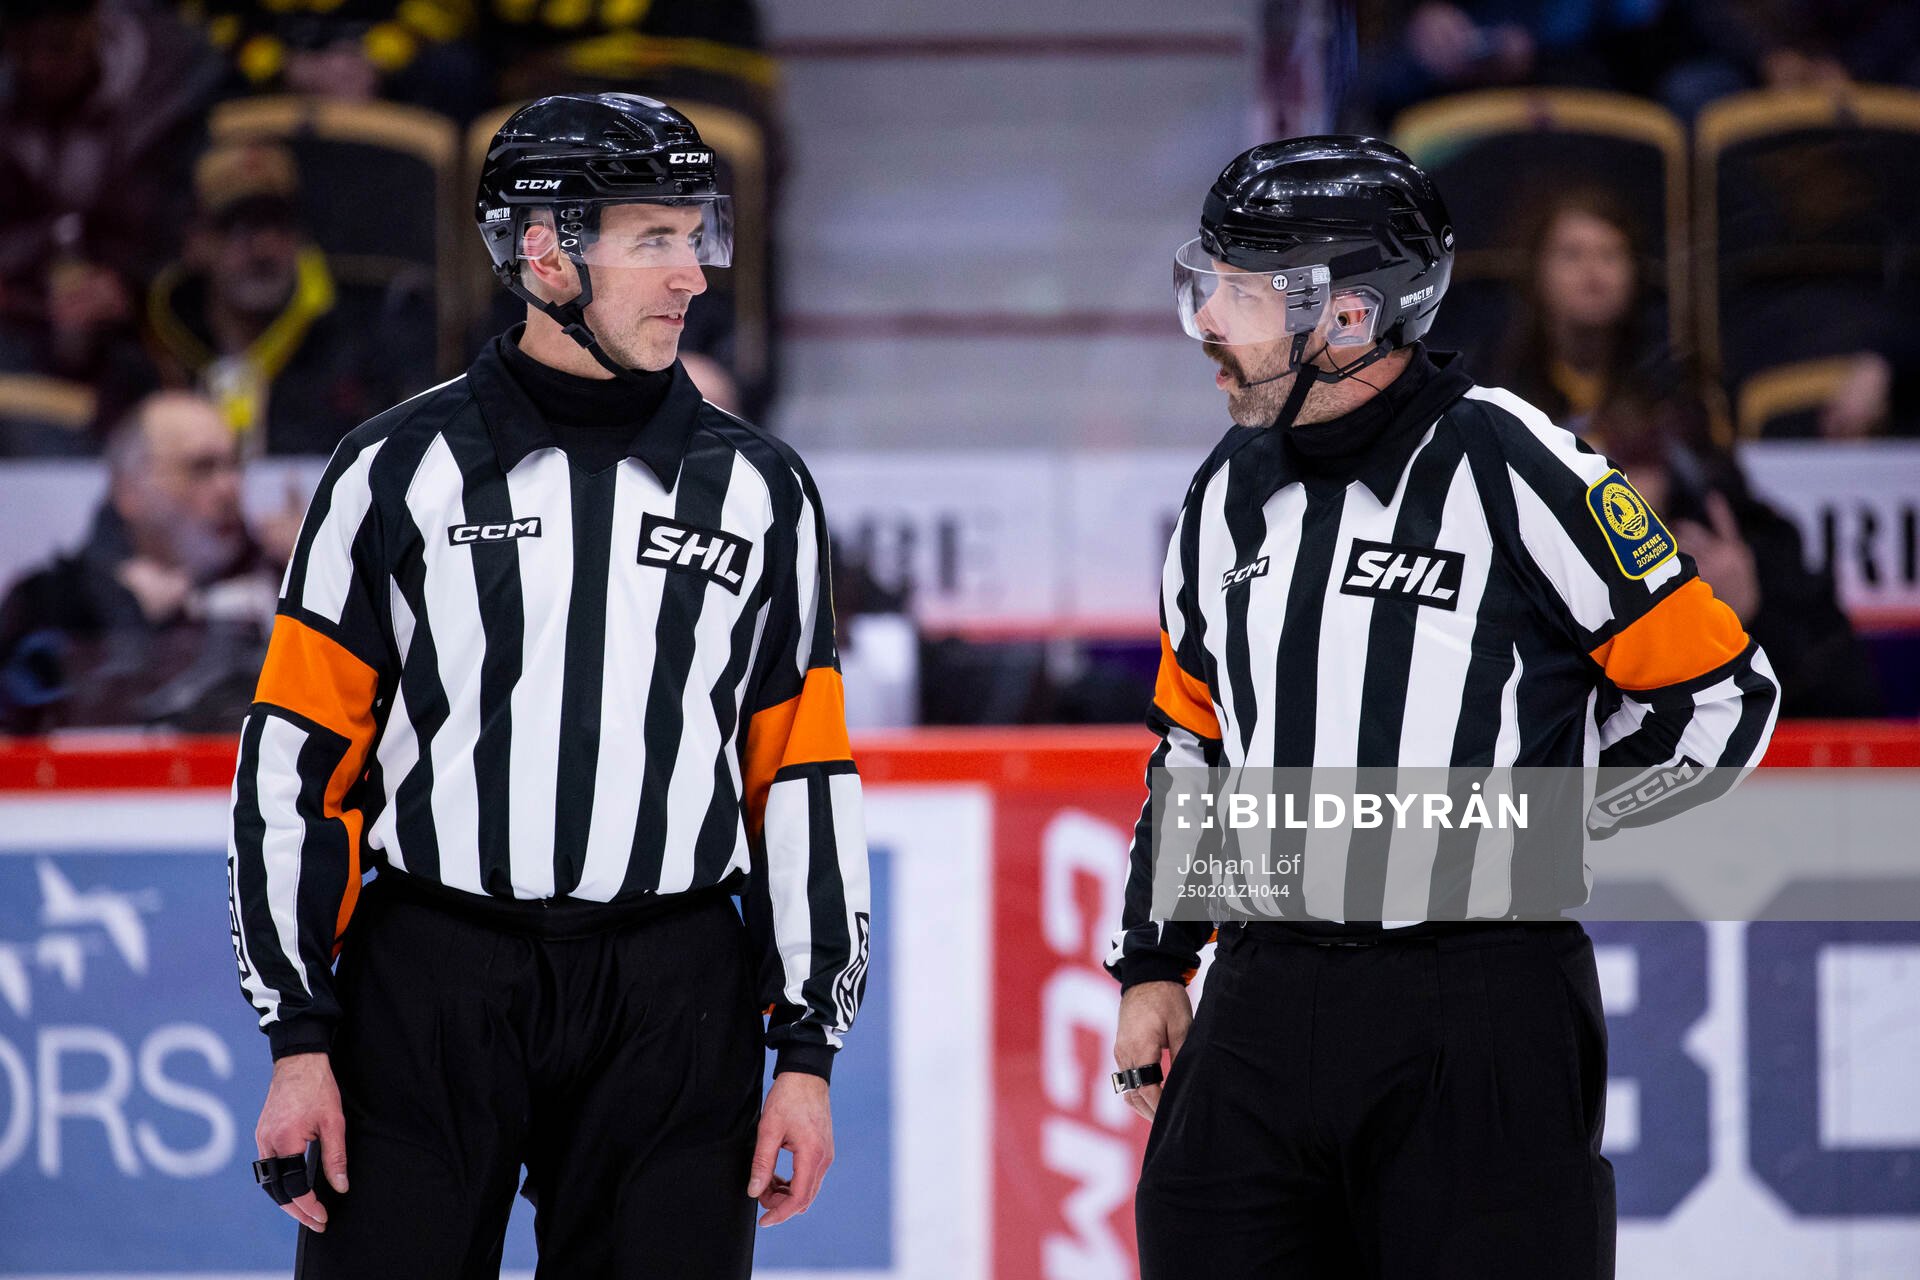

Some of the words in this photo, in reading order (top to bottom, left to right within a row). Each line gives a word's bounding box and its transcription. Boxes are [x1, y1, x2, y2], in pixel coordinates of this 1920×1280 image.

[669, 152, 709, 164] CCM
[514, 179, 562, 190] CCM
[1400, 289, 1425, 307] IMPACT
[1426, 284, 1434, 297] BY
[453, 519, 538, 542] CCM
[641, 525, 742, 585] SHL
[1632, 533, 1663, 559] REFEREE
[1636, 541, 1668, 569] 2024/2025
[1222, 557, 1268, 588] CCM
[1345, 550, 1456, 600] SHL
[1608, 761, 1695, 815] CCM
[1041, 808, 1133, 1280] CCM
[0, 1022, 238, 1180] RS
